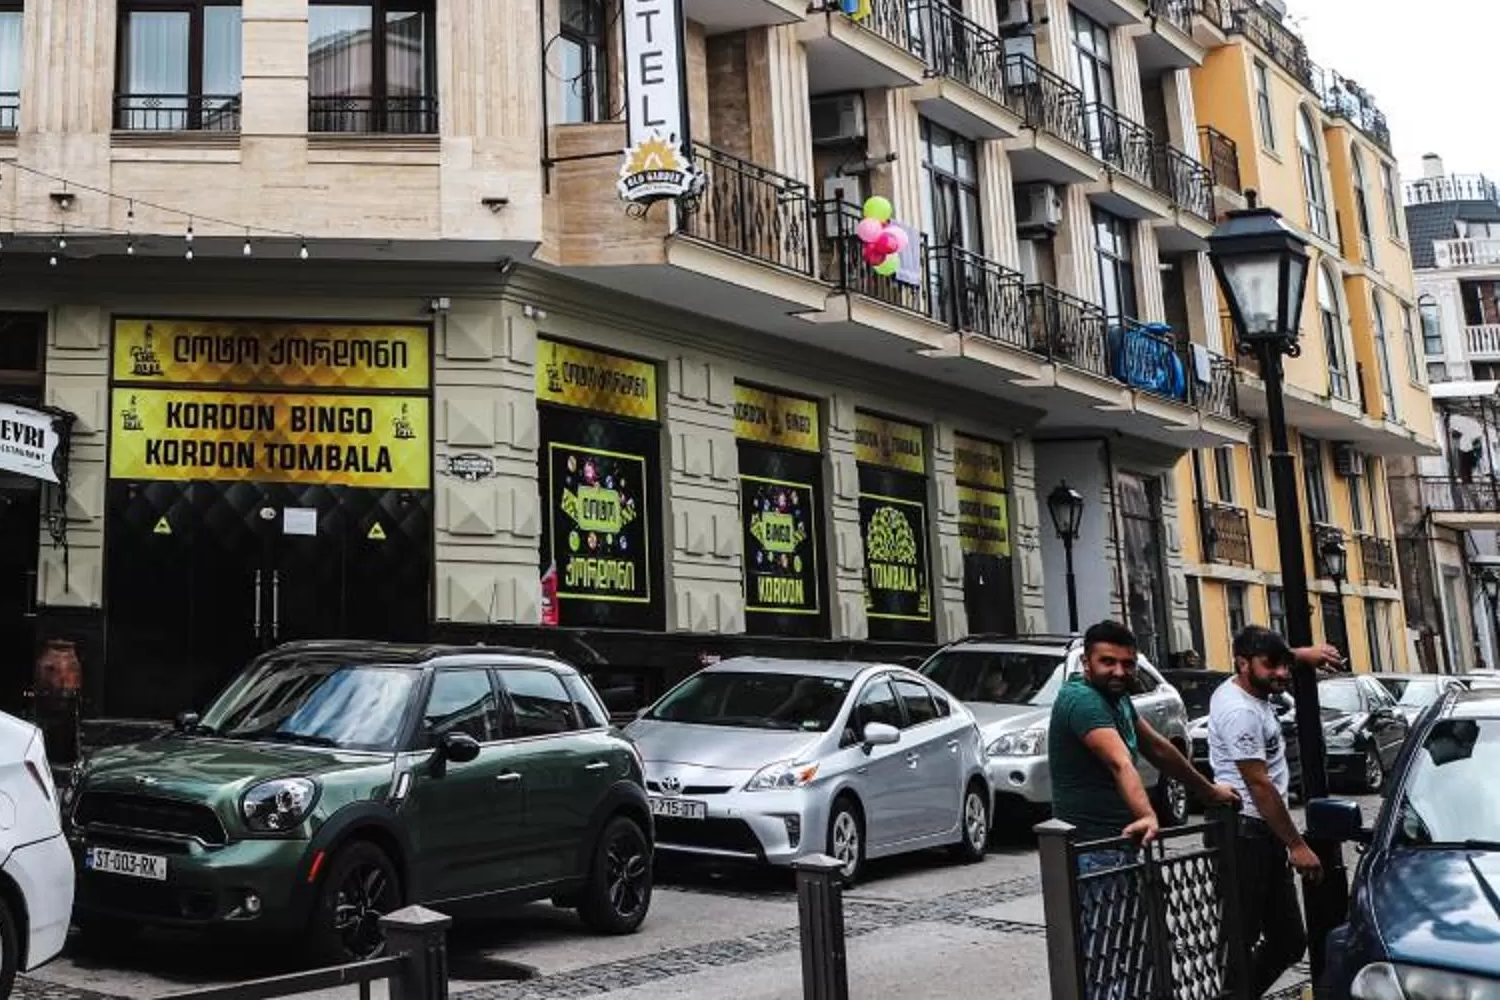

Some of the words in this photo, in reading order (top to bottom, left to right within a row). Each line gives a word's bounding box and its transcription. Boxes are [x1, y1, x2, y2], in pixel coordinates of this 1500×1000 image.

[173, 334, 259, 365] ლოტო
[166, 401, 275, 431] KORDON
[291, 406, 373, 434] BINGO
[145, 439, 256, 469] KORDON
[262, 443, 392, 473] TOMBALA
[757, 576, 805, 604] KORDON
[869, 562, 917, 591] TOMBALA
[95, 852, 157, 876] ST-003-RK
